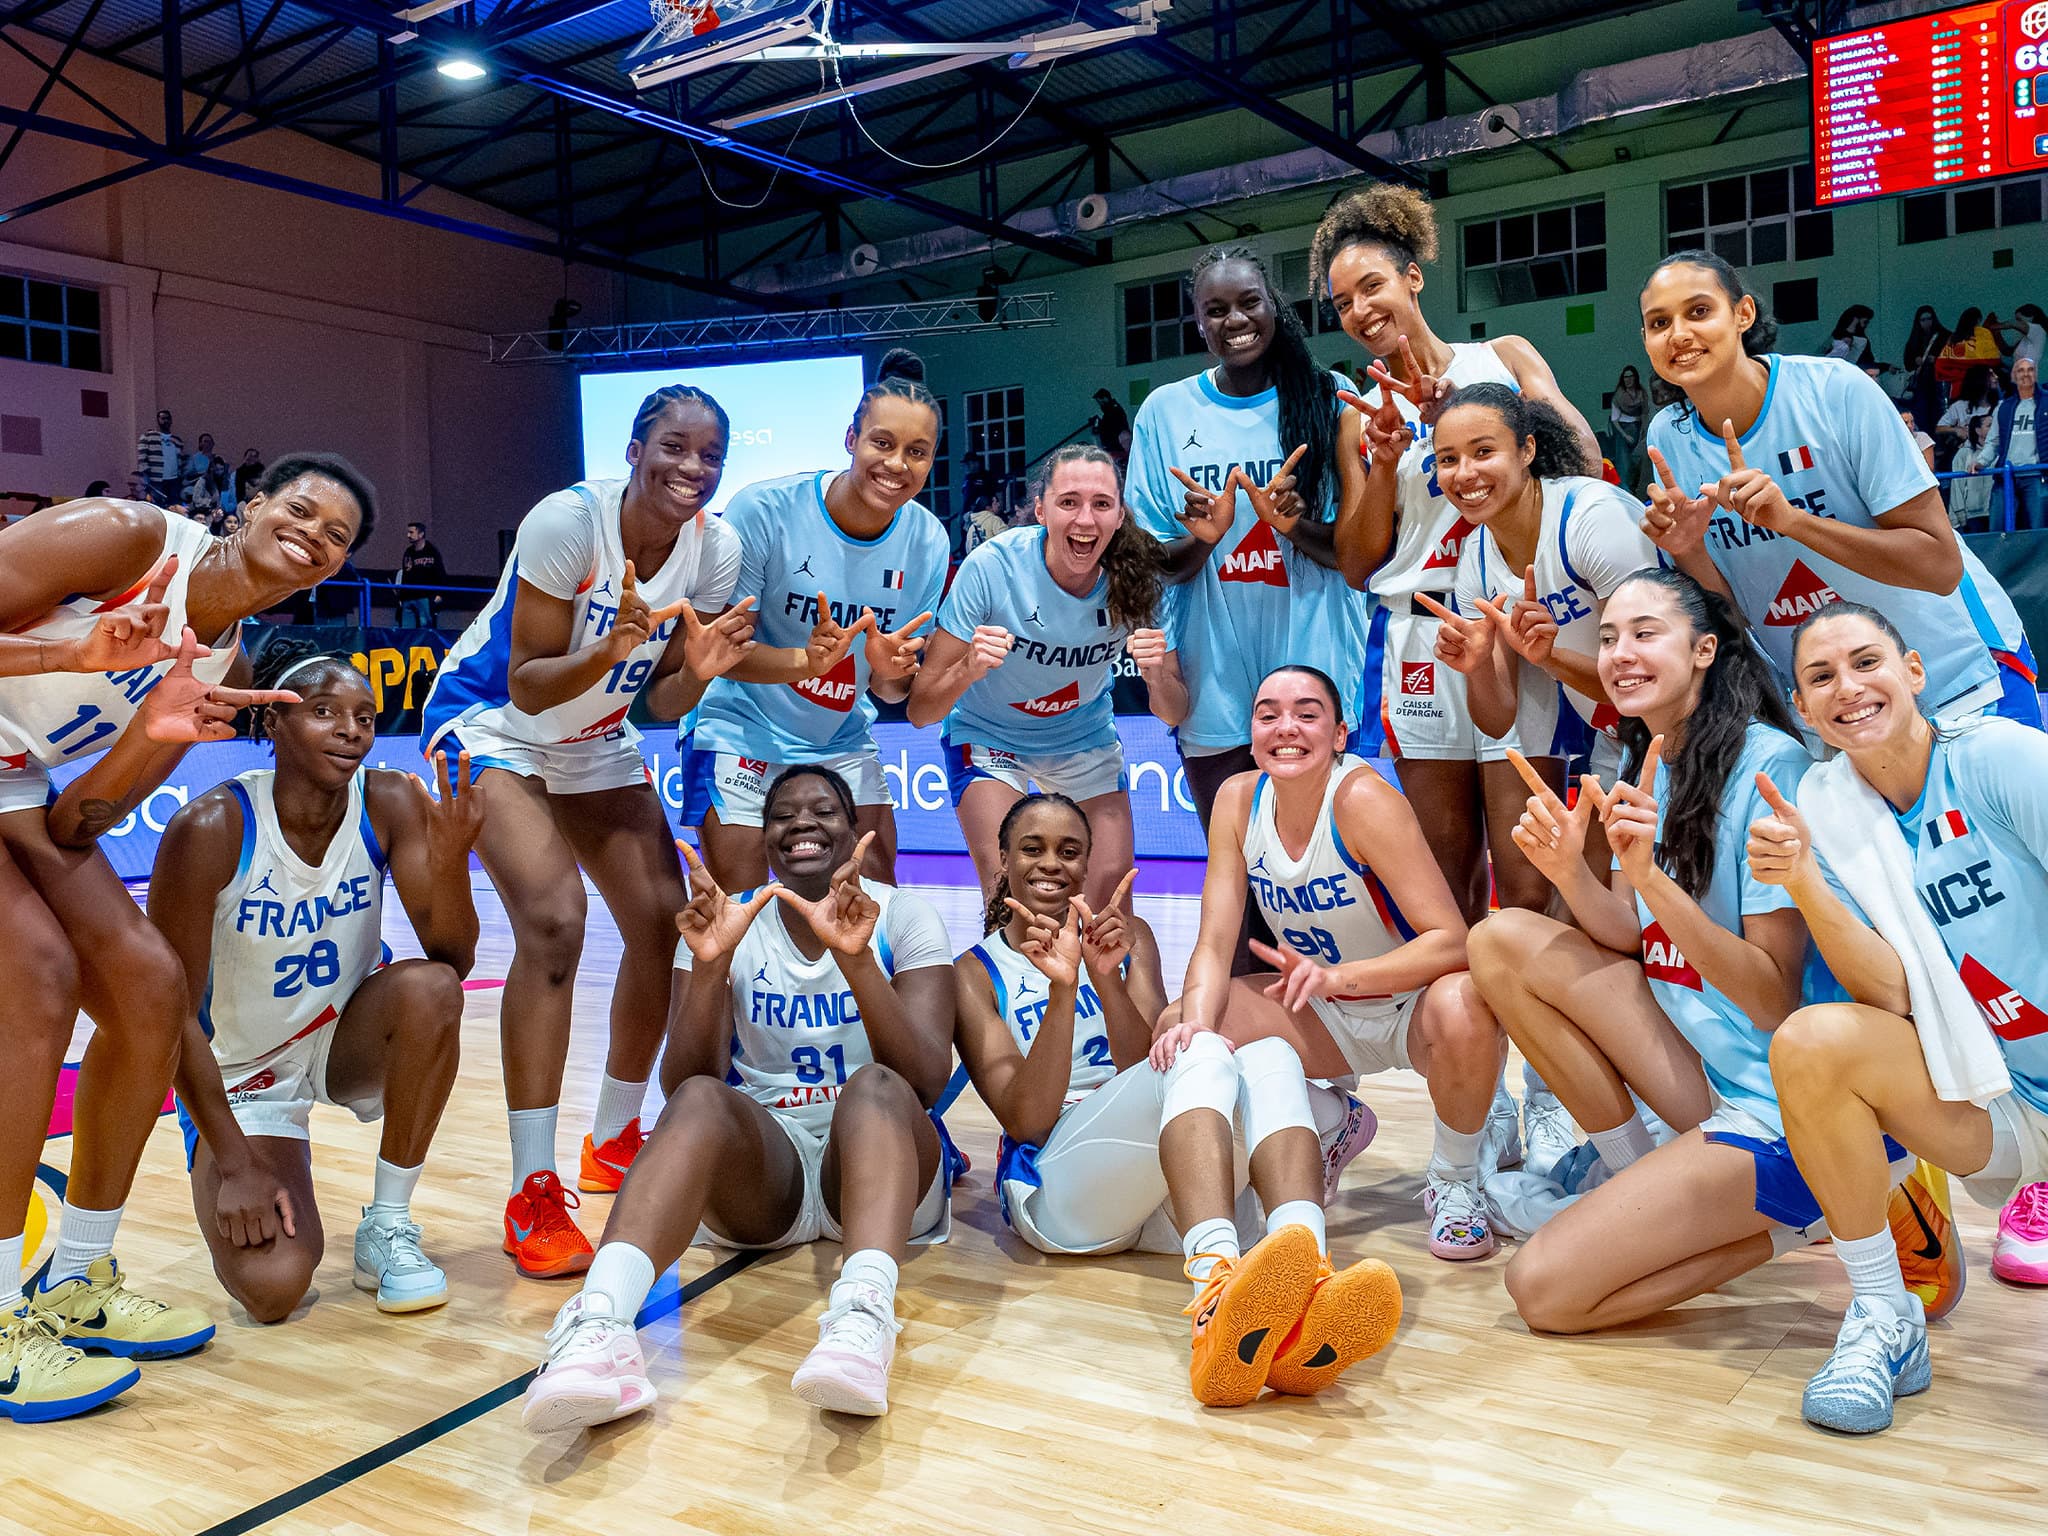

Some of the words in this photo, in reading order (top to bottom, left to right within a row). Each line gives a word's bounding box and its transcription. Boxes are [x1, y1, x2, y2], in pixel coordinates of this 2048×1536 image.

[1829, 35, 1872, 50] MENDEZ,
[1829, 47, 1875, 62] SORIANO,
[1830, 86, 1862, 99] ORTIZ,
[1830, 98, 1867, 111] CONDE,
[1831, 147, 1871, 160] FLOREZ,
[1832, 185, 1873, 198] MARTIN,
[1223, 549, 1283, 573] MAIF
[1768, 586, 1837, 621] MAIF
[1011, 635, 1121, 668] FRANCE
[605, 660, 653, 694] 19
[797, 678, 855, 701] MAIF
[1023, 698, 1080, 713] MAIF
[1402, 700, 1434, 709] CAISSE
[47, 705, 118, 756] 11
[736, 772, 761, 788] CAISSE
[1248, 873, 1356, 914] FRANCE
[236, 875, 373, 938] FRANCE
[1282, 926, 1342, 965] 98
[273, 939, 340, 998] 28
[751, 990, 862, 1029] FRANC
[790, 1044, 847, 1085] 31
